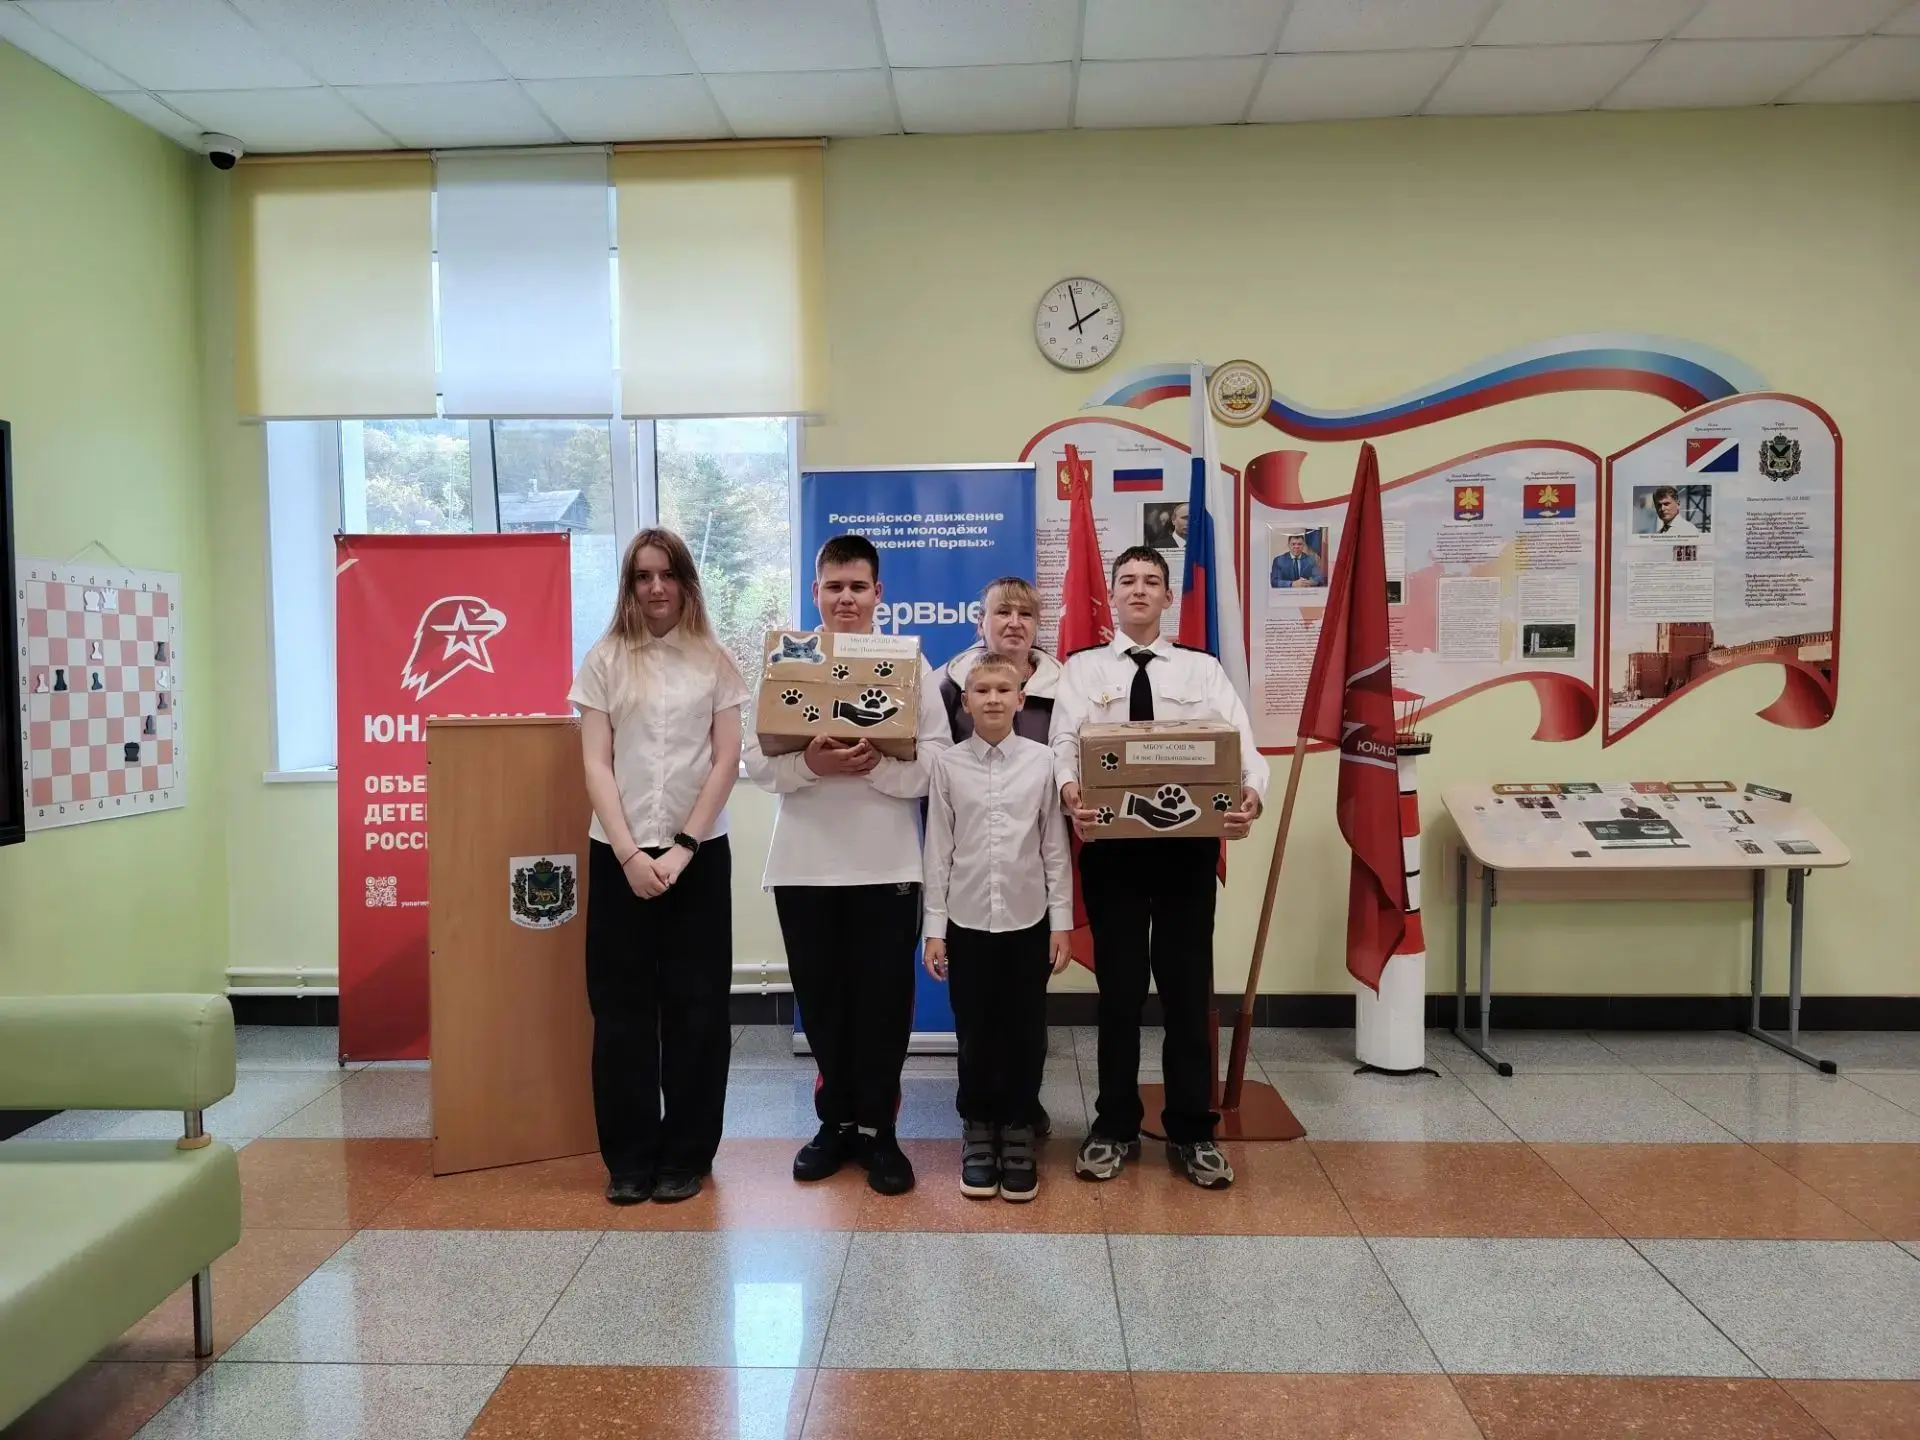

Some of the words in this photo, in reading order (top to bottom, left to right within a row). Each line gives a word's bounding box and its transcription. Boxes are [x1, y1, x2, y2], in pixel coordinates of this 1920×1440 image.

[1073, 287, 1083, 295] 12
[1048, 305, 1059, 313] 10
[1101, 302, 1109, 310] 2
[1049, 337, 1057, 345] 8
[1061, 347, 1068, 356] 7
[1090, 345, 1098, 353] 5
[1075, 351, 1083, 359] 6
[828, 512, 922, 524] Российское
[924, 513, 1004, 524] движение
[894, 527, 904, 536] и
[907, 525, 988, 536] молодёжи
[929, 538, 995, 550] Первых»
[31, 571, 37, 579] a
[51, 571, 57, 581] b
[70, 575, 76, 583] c
[89, 575, 95, 585] d
[141, 582, 147, 592] g
[18, 590, 25, 600] 8
[20, 617, 26, 627] 7
[873, 601, 982, 634] ервые
[21, 646, 27, 657] 6
[21, 676, 27, 686] 5
[21, 703, 27, 713] 4
[22, 731, 28, 741] 3
[23, 760, 29, 770] 2
[364, 775, 428, 794] ОБЪЕ
[24, 788, 30, 798] 1
[38, 808, 45, 817] a
[59, 804, 65, 815] b
[79, 803, 85, 811] c
[98, 799, 104, 809] d
[149, 793, 155, 804] g
[163, 790, 169, 800] h
[364, 803, 428, 825] ДЕТЕ
[365, 831, 428, 850] РОСС
